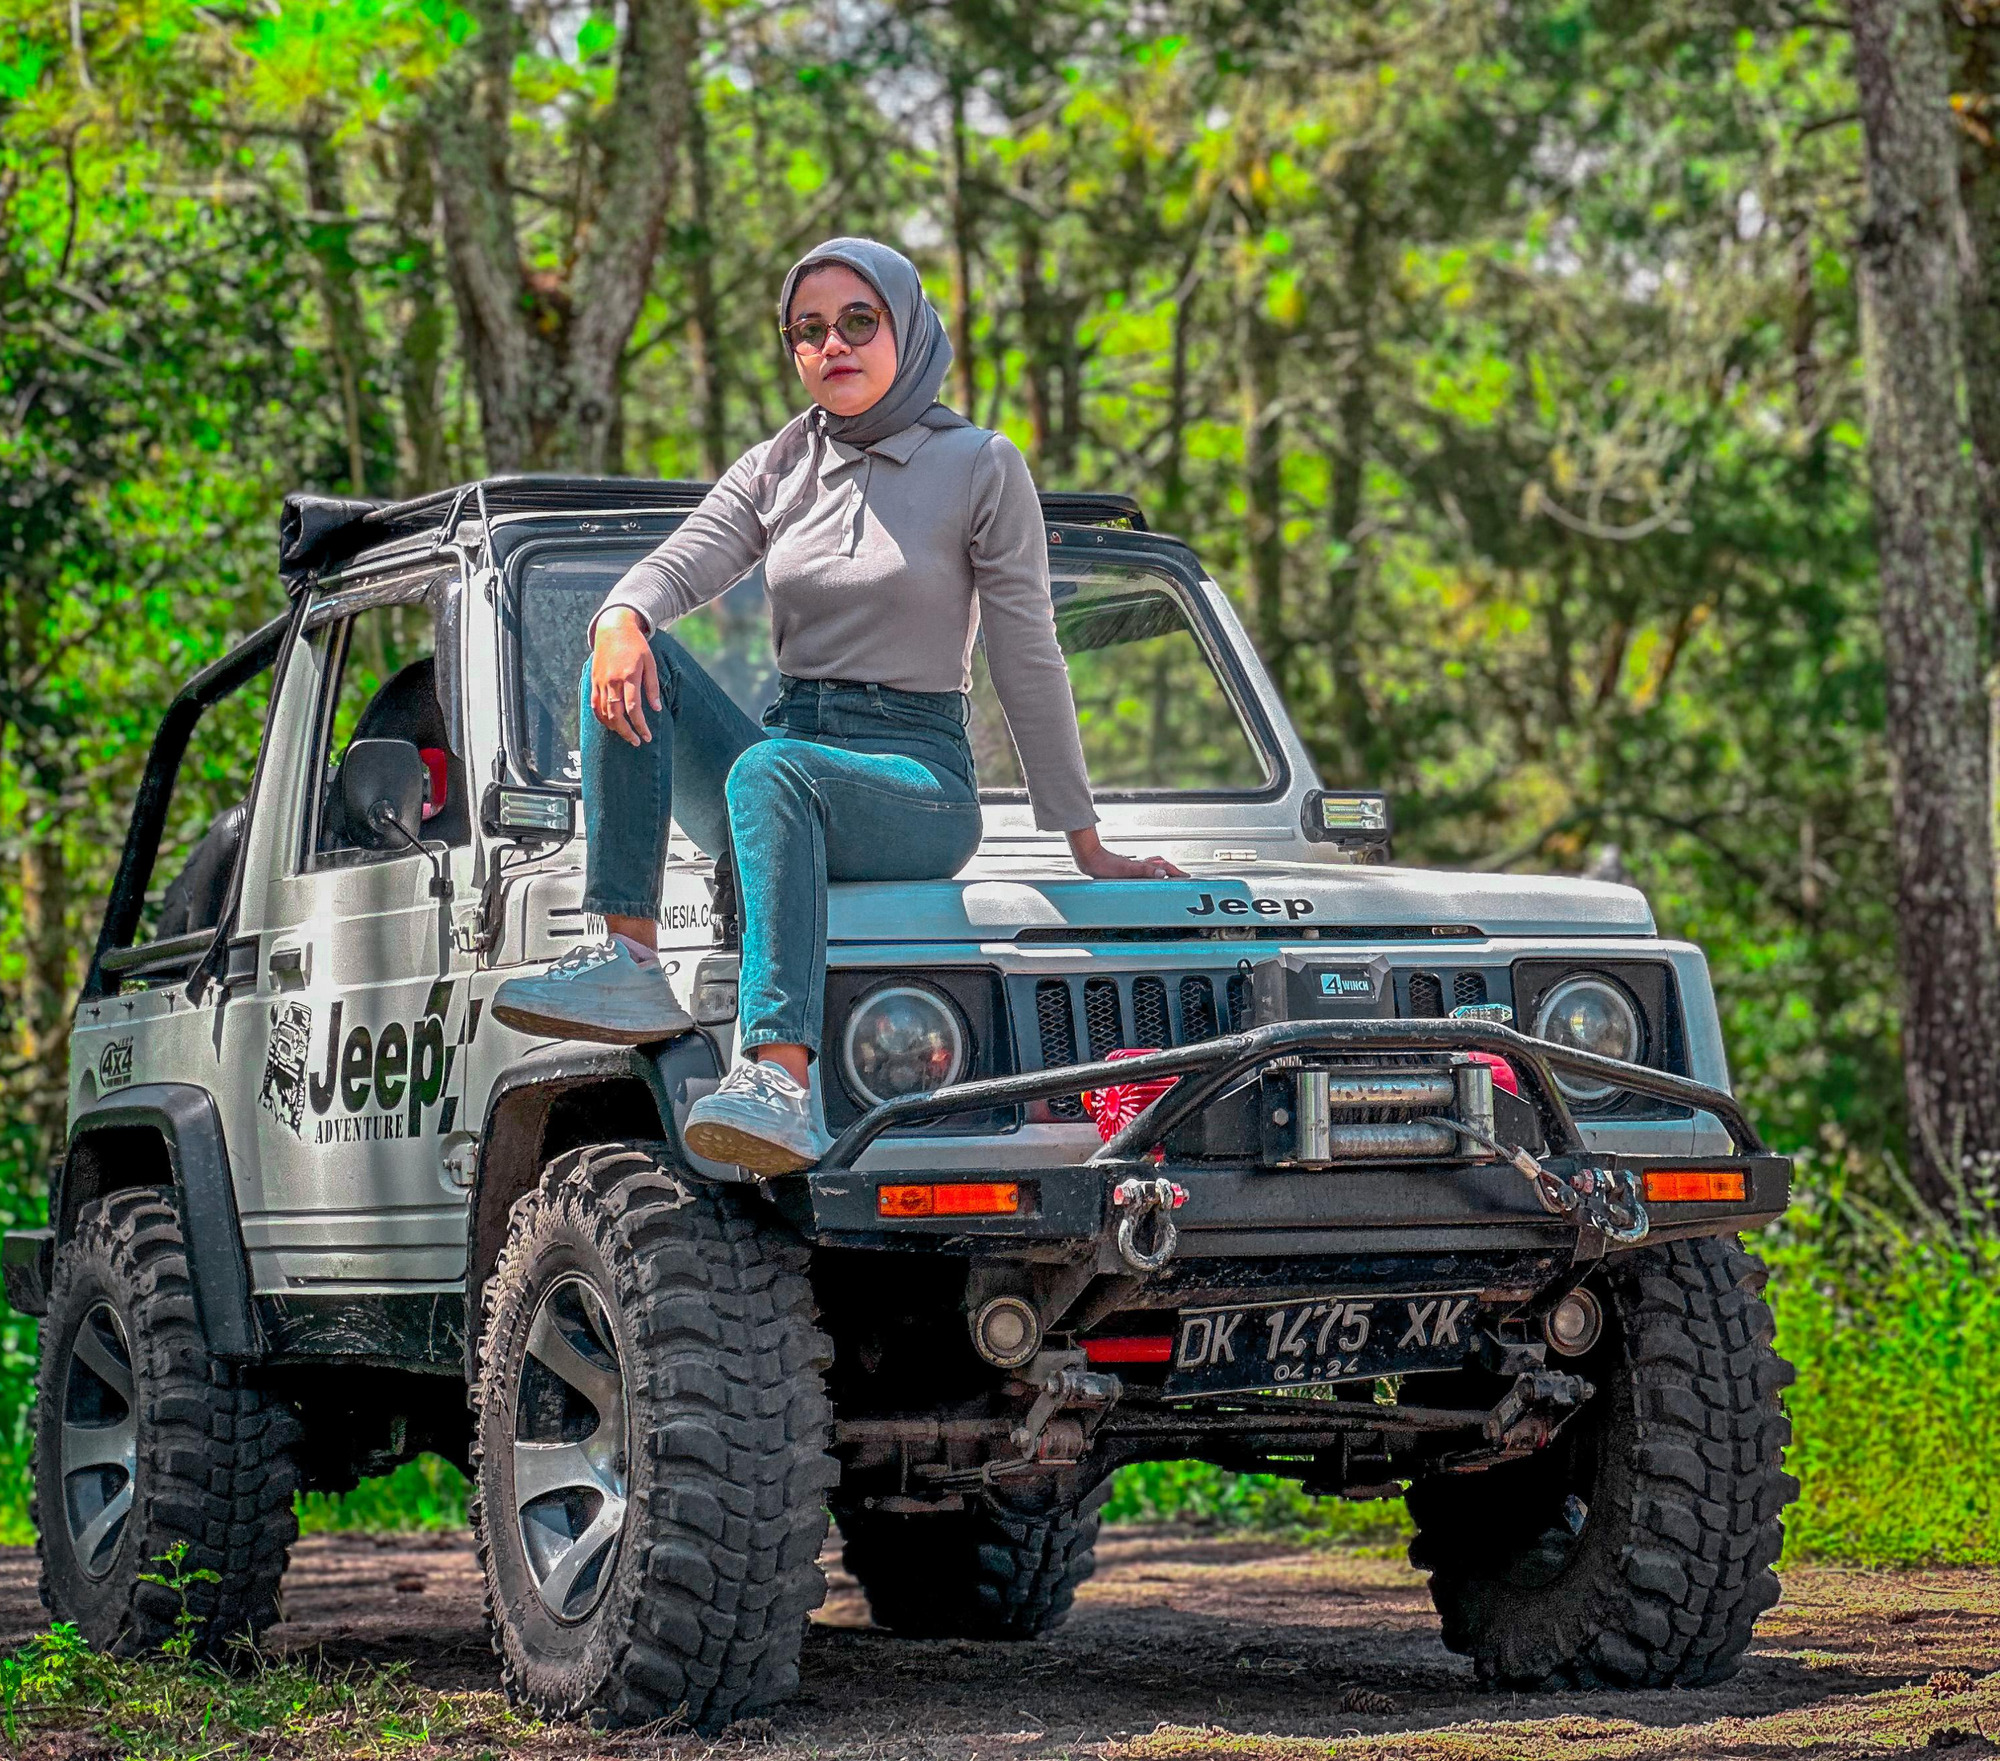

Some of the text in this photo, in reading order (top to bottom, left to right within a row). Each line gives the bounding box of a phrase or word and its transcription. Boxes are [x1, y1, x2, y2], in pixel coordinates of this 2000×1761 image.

[1186, 893, 1315, 921] Jeep
[1342, 979, 1370, 992] WINCH
[308, 1000, 445, 1138] Jeep
[314, 1113, 404, 1145] ADVENTURE
[1176, 1299, 1470, 1368] DK 1475 XK
